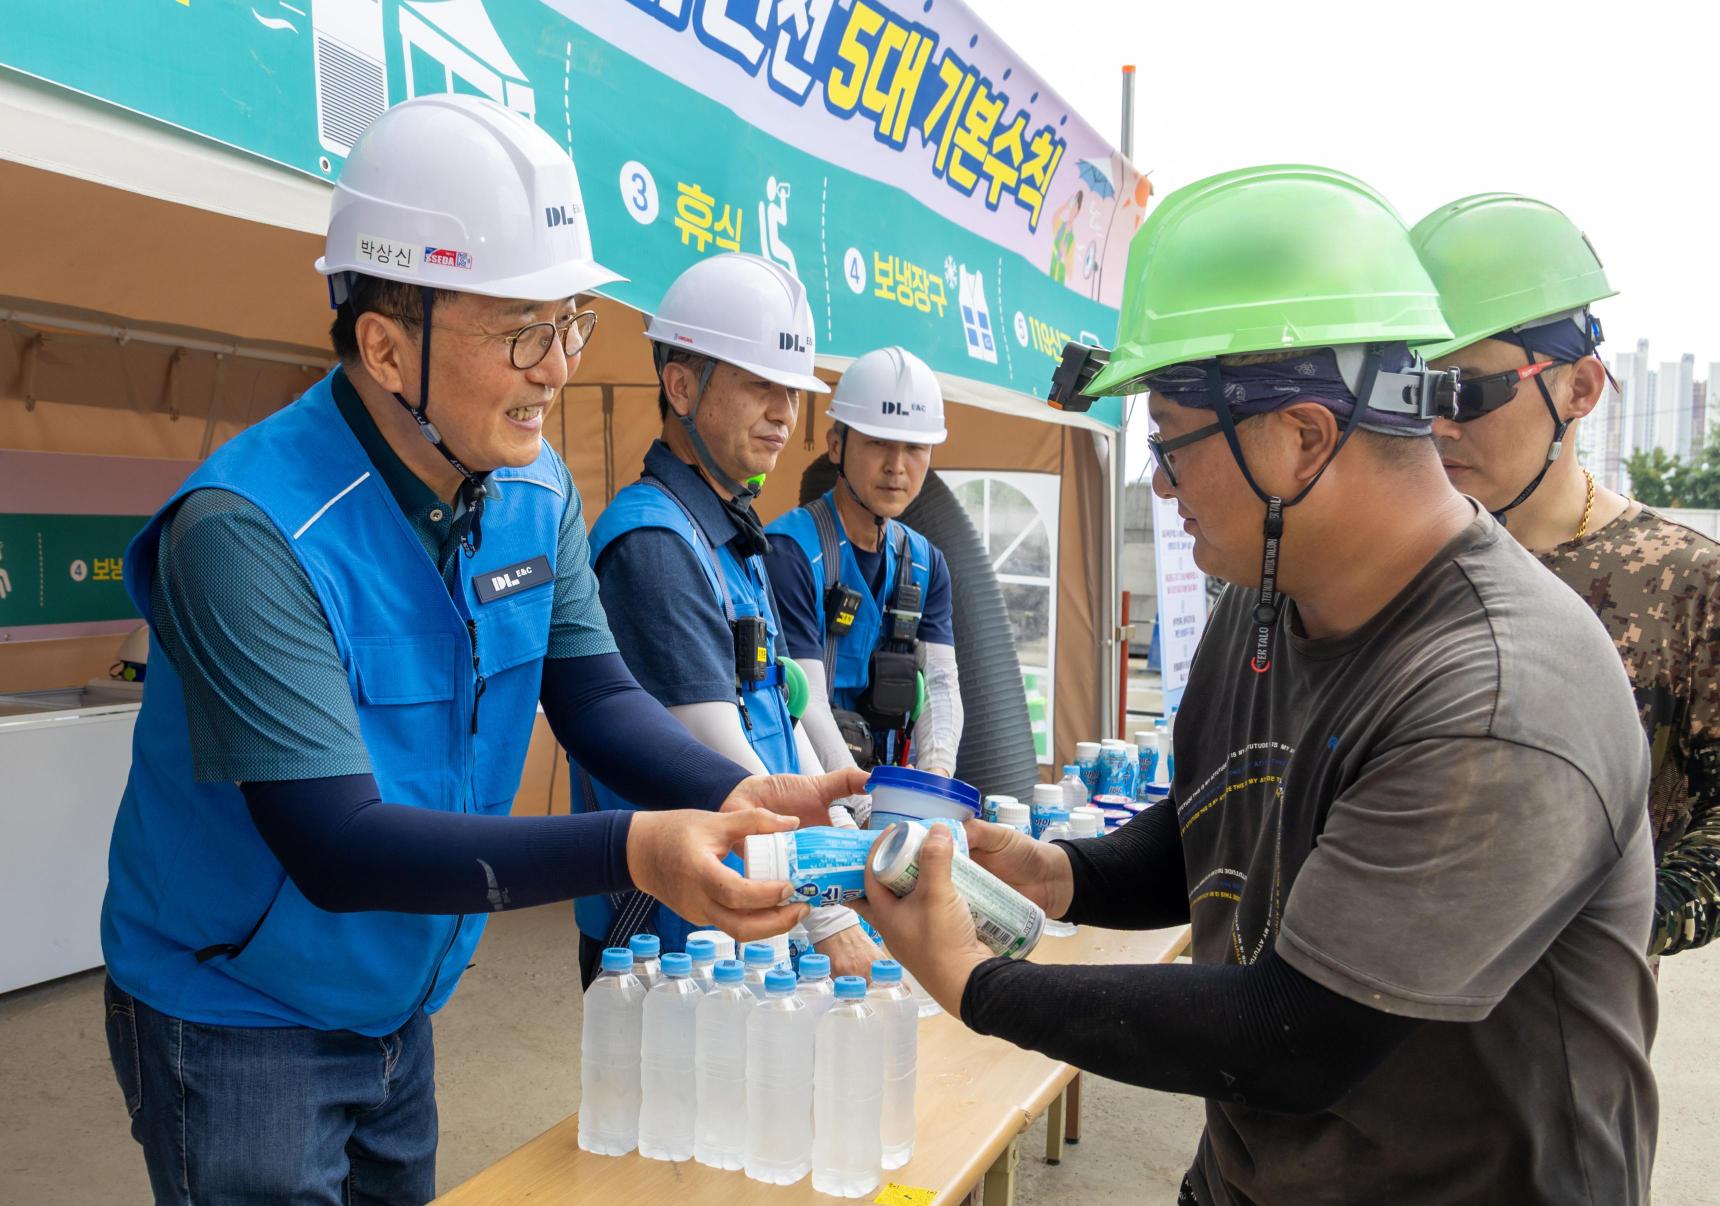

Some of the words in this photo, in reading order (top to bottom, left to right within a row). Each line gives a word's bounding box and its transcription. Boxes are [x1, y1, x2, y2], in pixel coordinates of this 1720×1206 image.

[828, 1, 934, 143] 5대
[923, 57, 1063, 228] 기본수칙
[545, 205, 573, 227] DL
[631, 172, 648, 211] 3
[675, 181, 742, 253] 휴식
[361, 239, 411, 268] 박상신
[850, 257, 860, 285] 4
[874, 251, 947, 317] 보냉장구
[779, 332, 805, 352] DL
[882, 401, 909, 416] DL
[492, 573, 520, 592] DL
[515, 566, 533, 577] E&C
[1257, 626, 1269, 649] TALO
